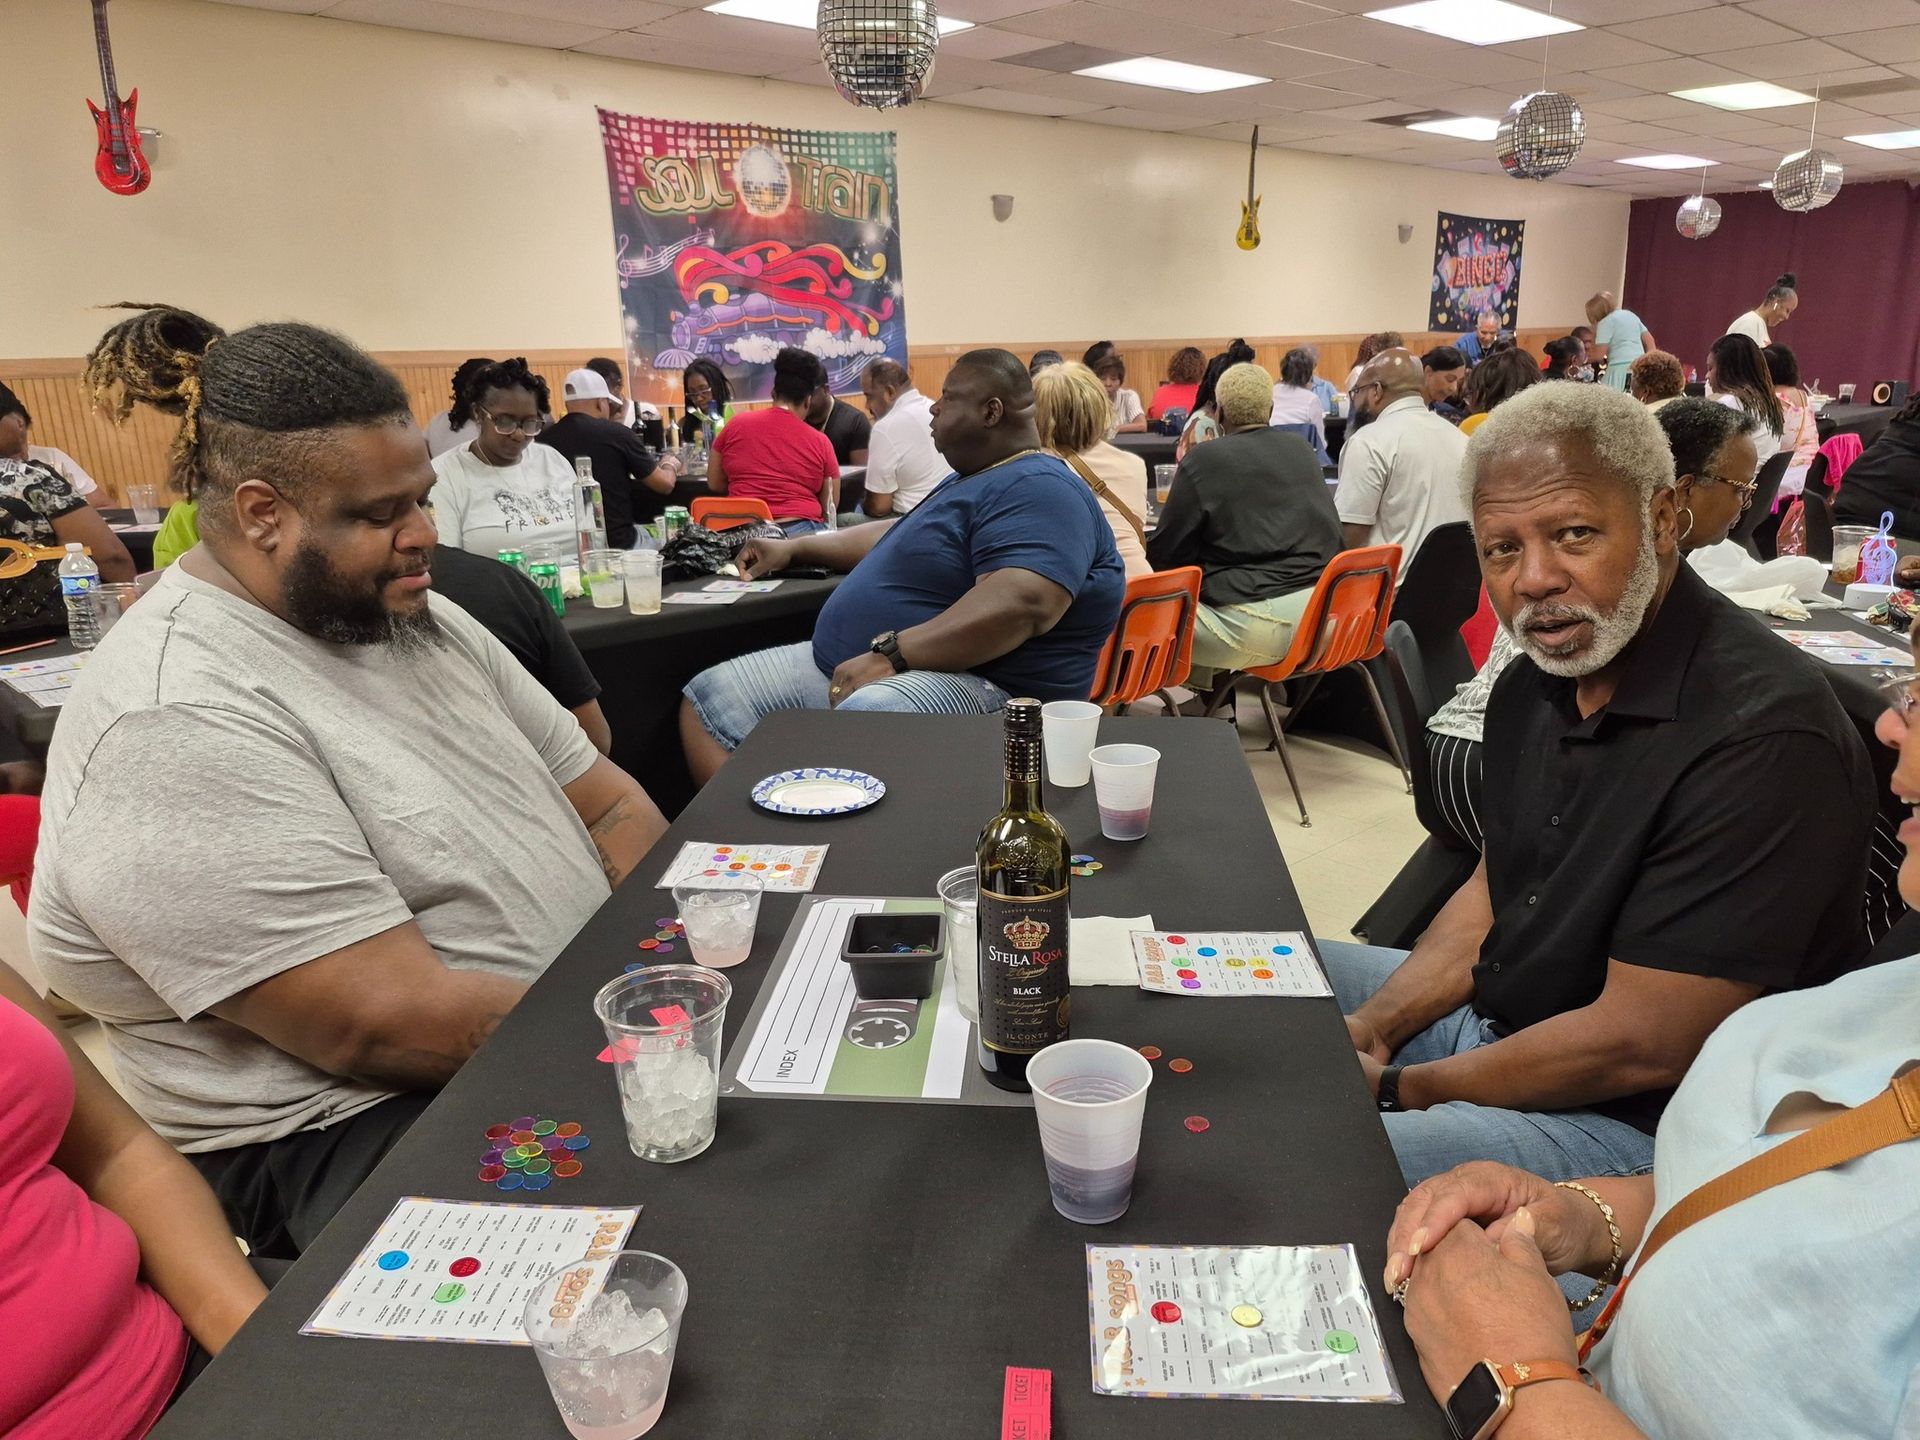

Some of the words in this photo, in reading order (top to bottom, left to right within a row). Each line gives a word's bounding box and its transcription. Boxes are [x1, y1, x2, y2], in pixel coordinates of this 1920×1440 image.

[1012, 986, 1042, 995] BLACK
[776, 1049, 799, 1079] INDEX
[587, 1221, 624, 1262] R&B
[1106, 1259, 1136, 1320] songs
[1014, 1374, 1029, 1402] TICKET
